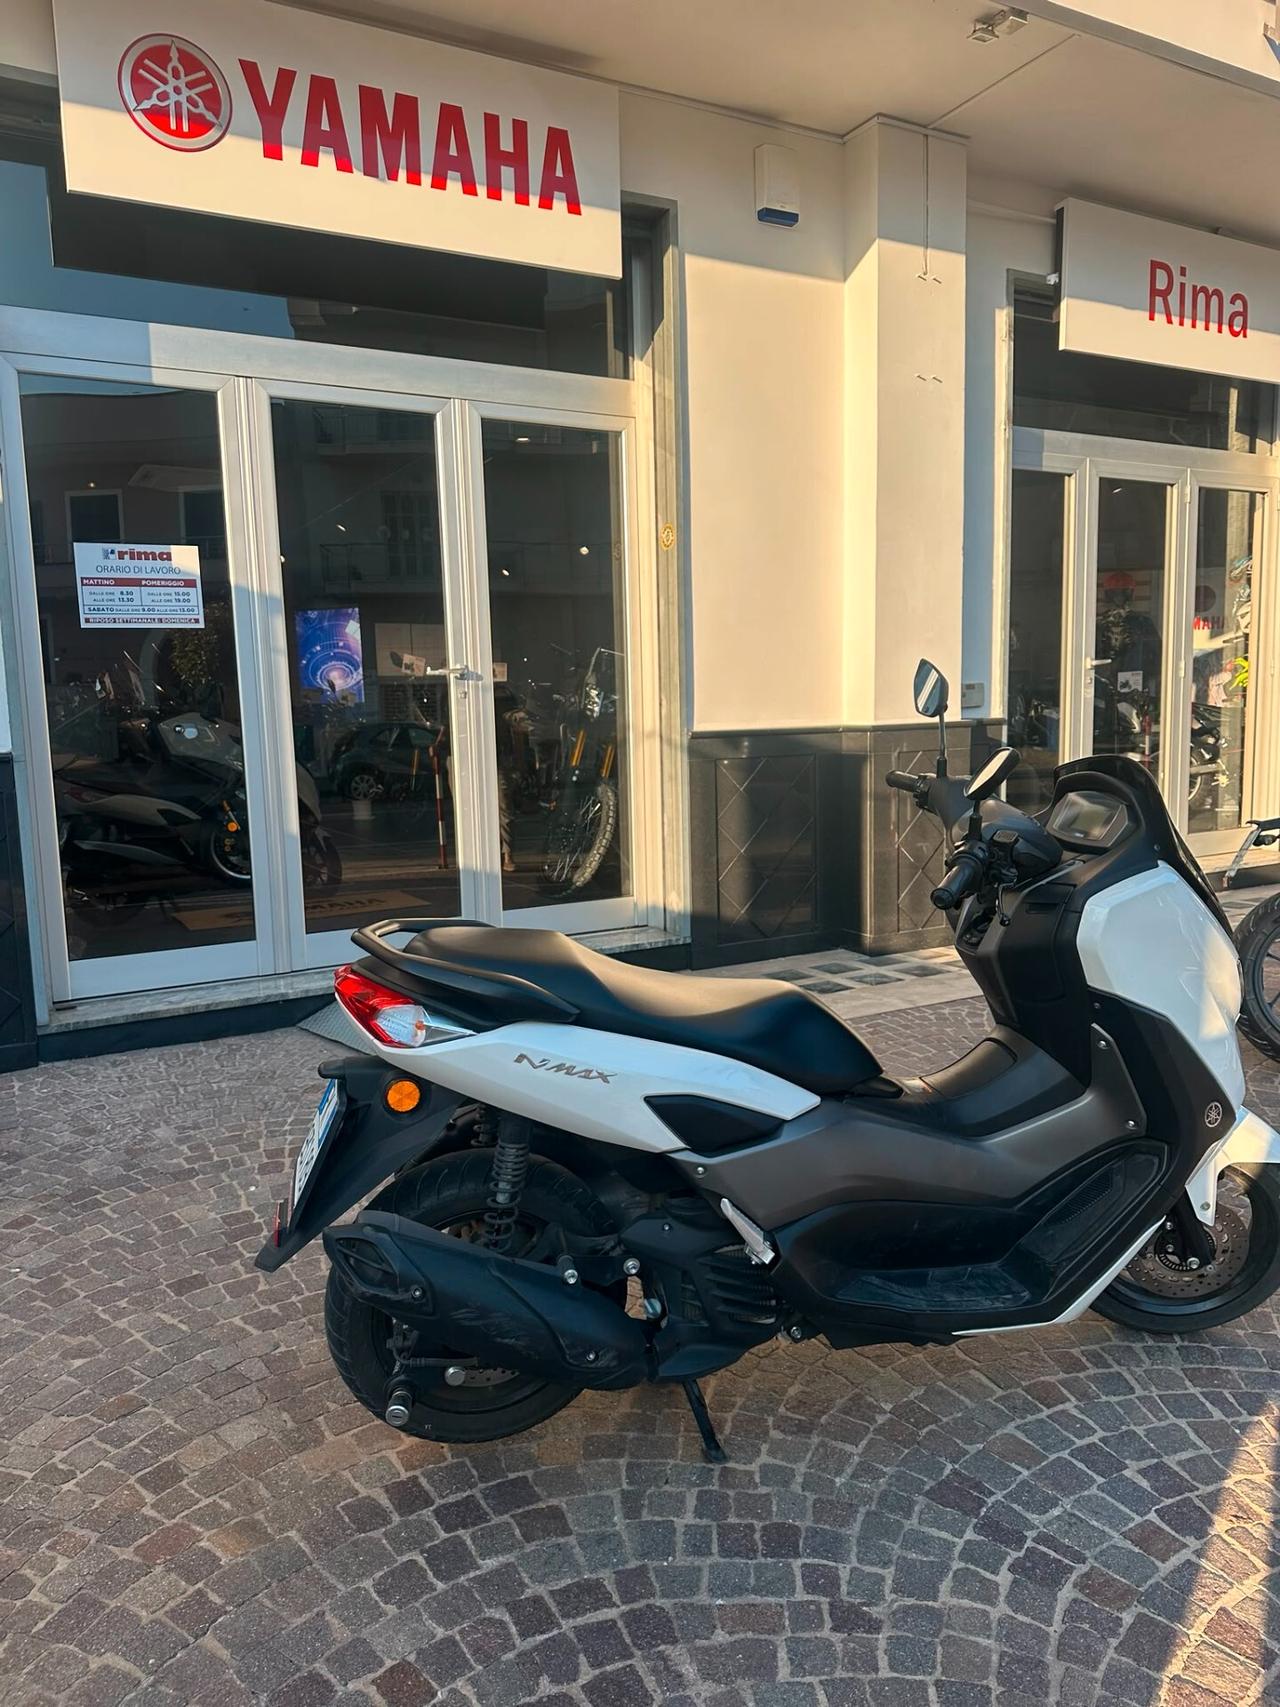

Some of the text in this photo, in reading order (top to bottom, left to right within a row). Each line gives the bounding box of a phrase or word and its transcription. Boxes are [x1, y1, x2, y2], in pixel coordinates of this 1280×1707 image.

[238, 58, 583, 216] YAMAHA
[1148, 259, 1249, 339] Rima
[95, 564, 181, 575] ORARIO DI LAVORO
[117, 548, 172, 561] rima
